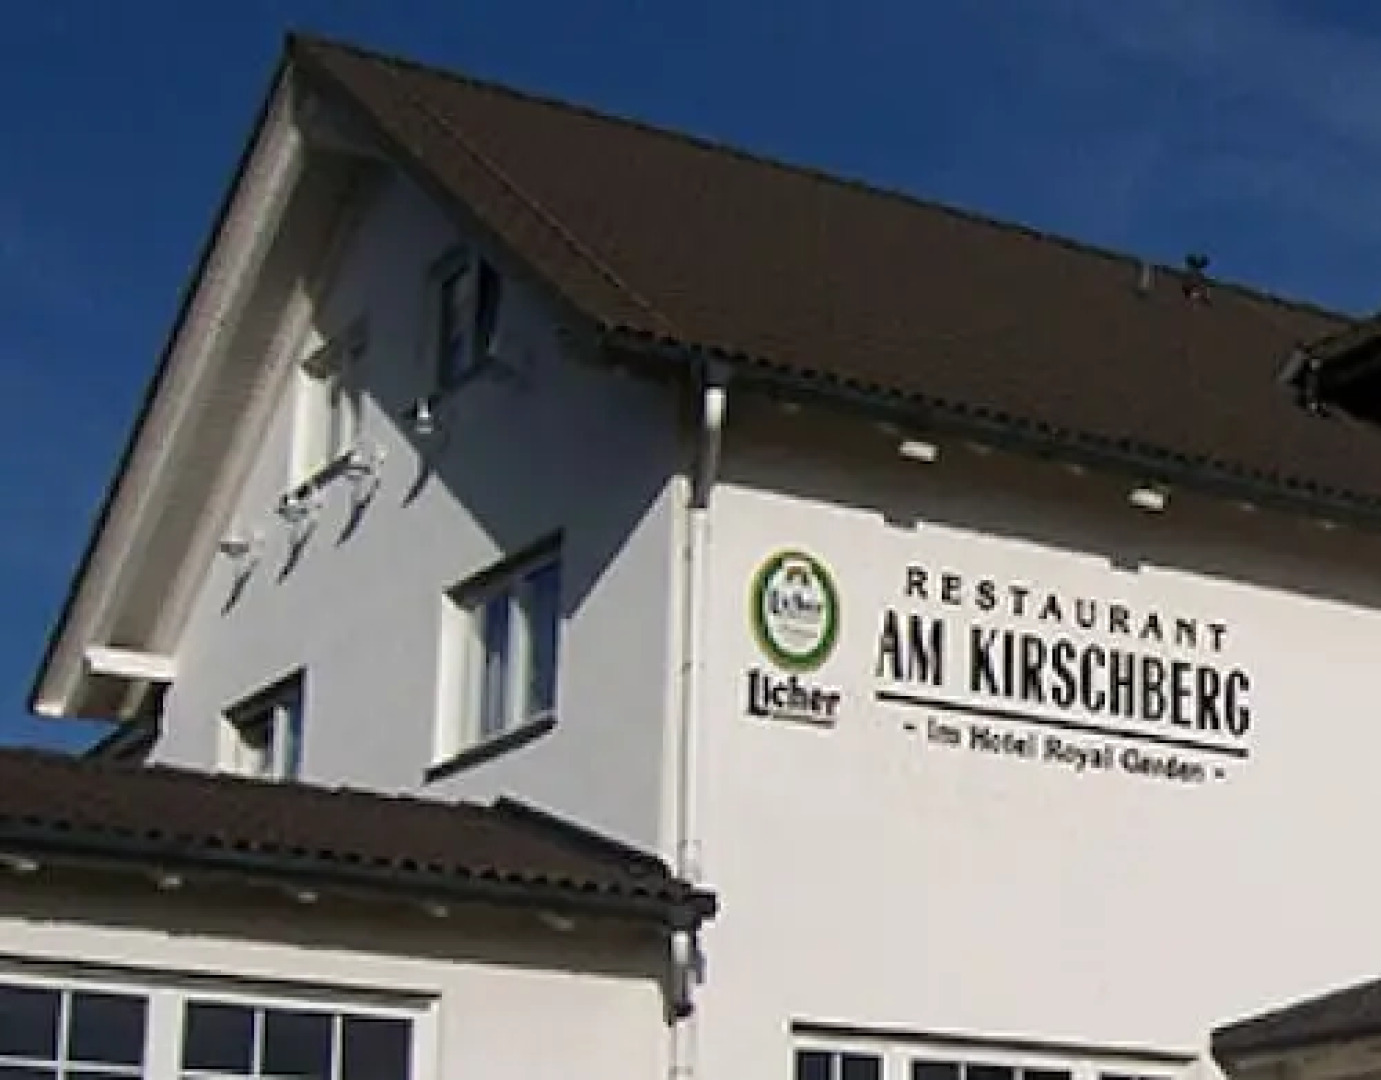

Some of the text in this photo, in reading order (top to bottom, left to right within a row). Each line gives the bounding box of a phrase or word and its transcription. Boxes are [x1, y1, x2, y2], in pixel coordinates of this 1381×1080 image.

[905, 565, 1228, 652] RESTAURANT
[746, 668, 841, 717] Licher
[875, 609, 1251, 736] AM KIRSCHBERG
[969, 724, 1036, 759] Hotel
[1044, 735, 1115, 775] Royal
